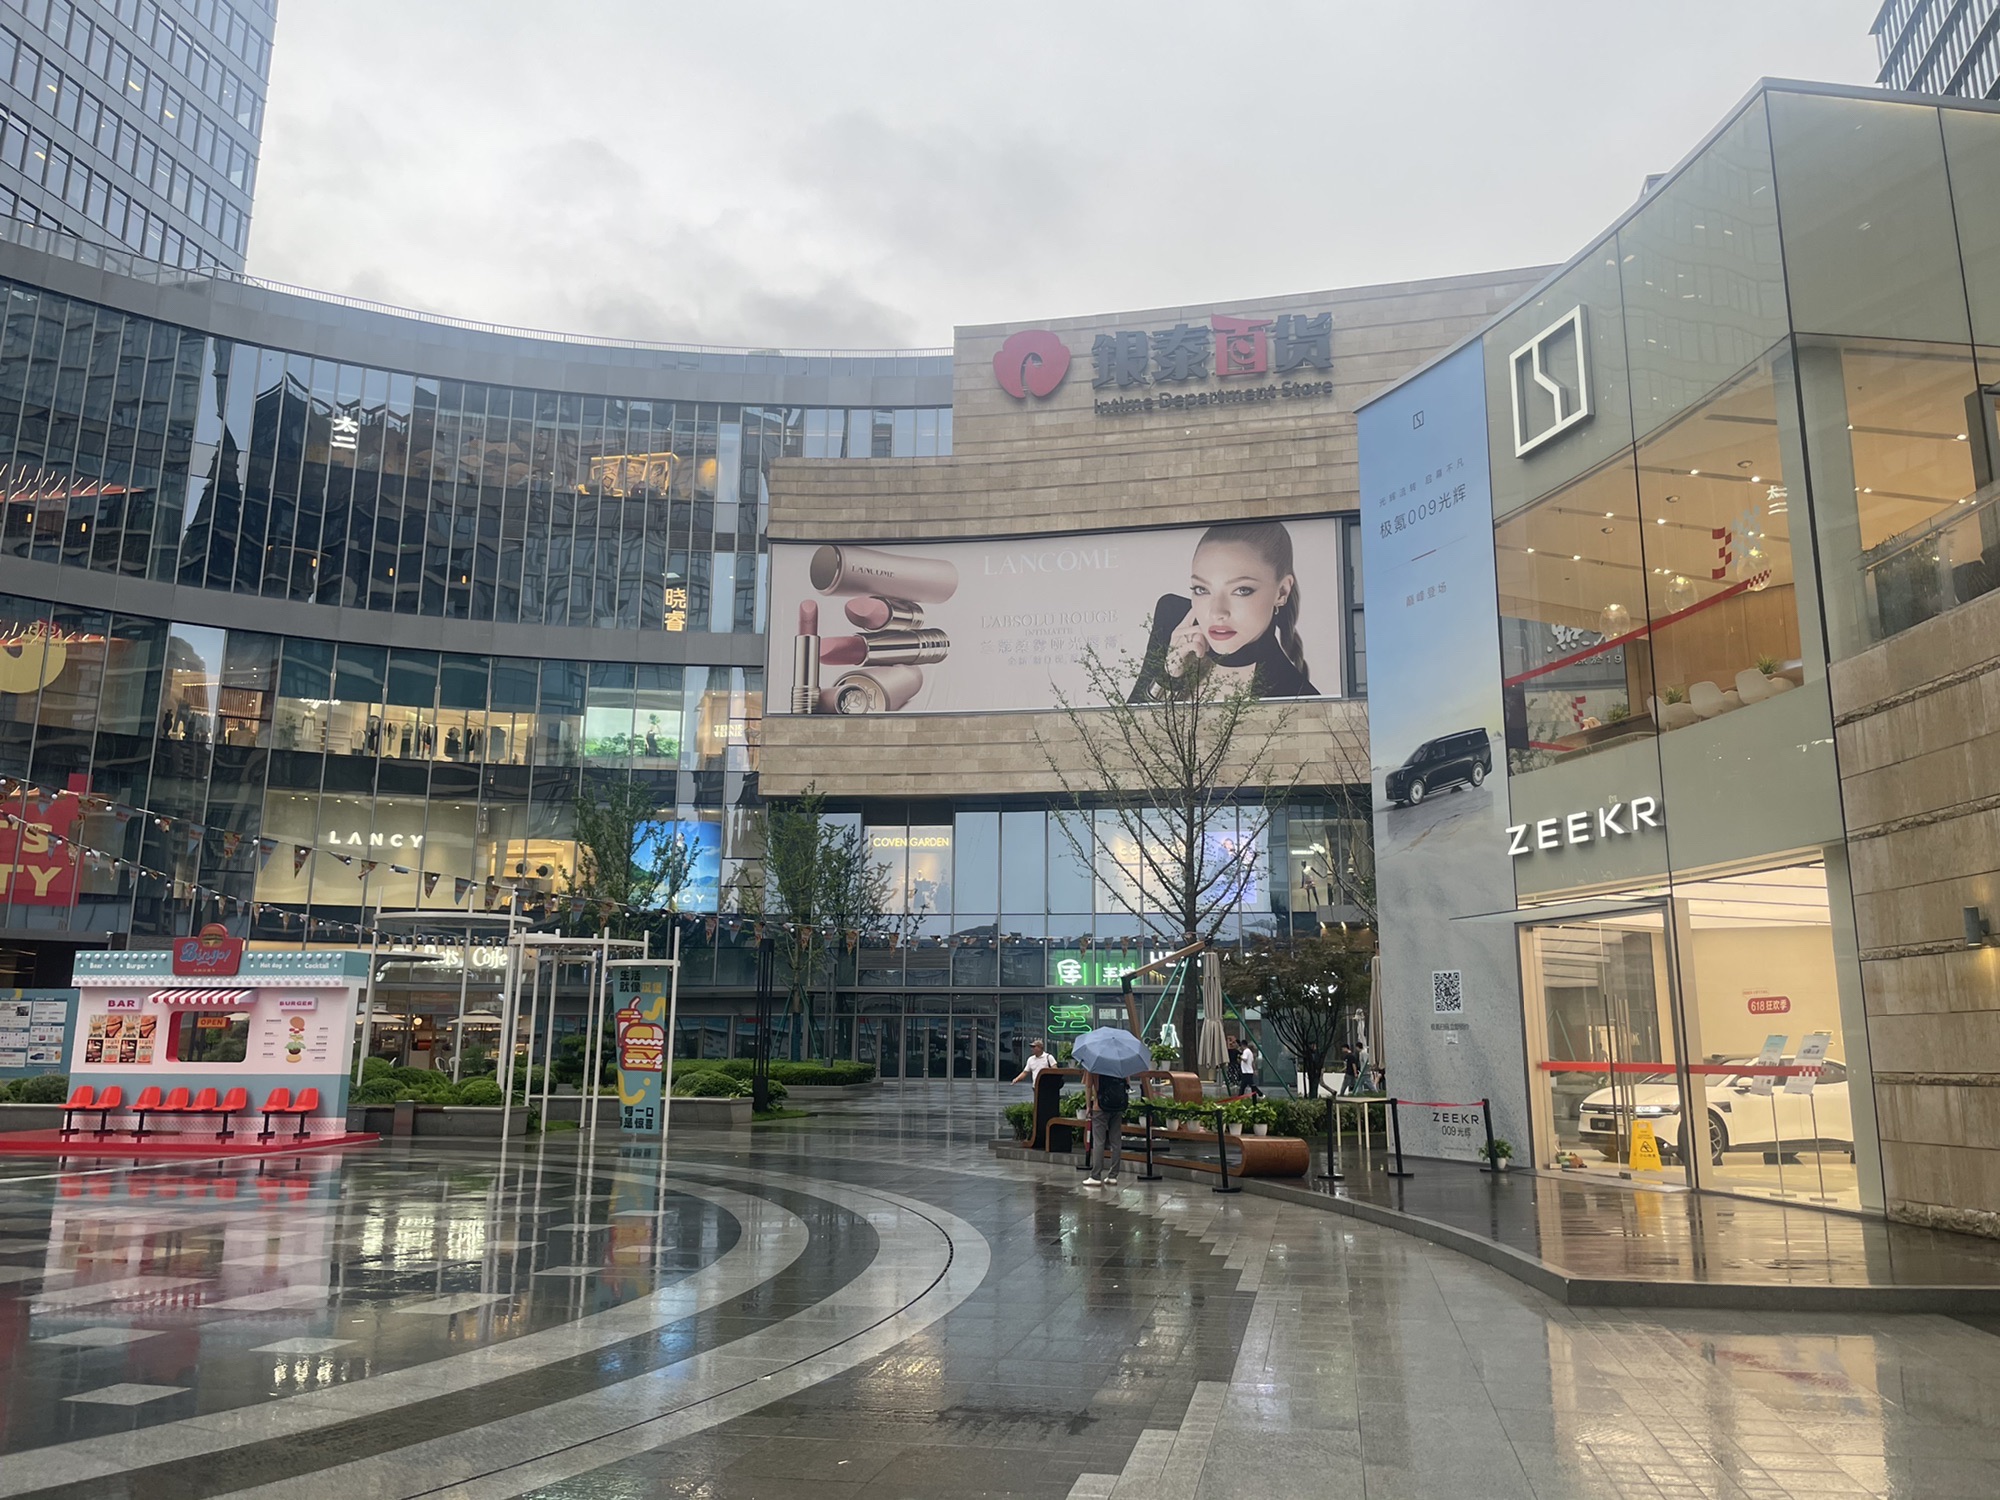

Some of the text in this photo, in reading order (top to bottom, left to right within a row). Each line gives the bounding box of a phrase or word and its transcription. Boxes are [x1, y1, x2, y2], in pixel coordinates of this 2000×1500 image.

[1092, 312, 1334, 389] 银泰百货
[1094, 380, 1333, 414] Intime Department Store
[1379, 483, 1467, 539] 极氪009光辉
[1060, 610, 1119, 625] ROUGE
[1505, 796, 1662, 856] ZEEKR
[328, 830, 424, 848] LANCY
[873, 837, 949, 847] COVEN GARDEN
[473, 946, 509, 968] Coffe
[620, 970, 641, 981] 生活
[107, 999, 135, 1008] BAR
[200, 1018, 224, 1026] OPEN
[624, 1105, 654, 1118] 每一口
[1433, 1112, 1480, 1125] ZEEKR
